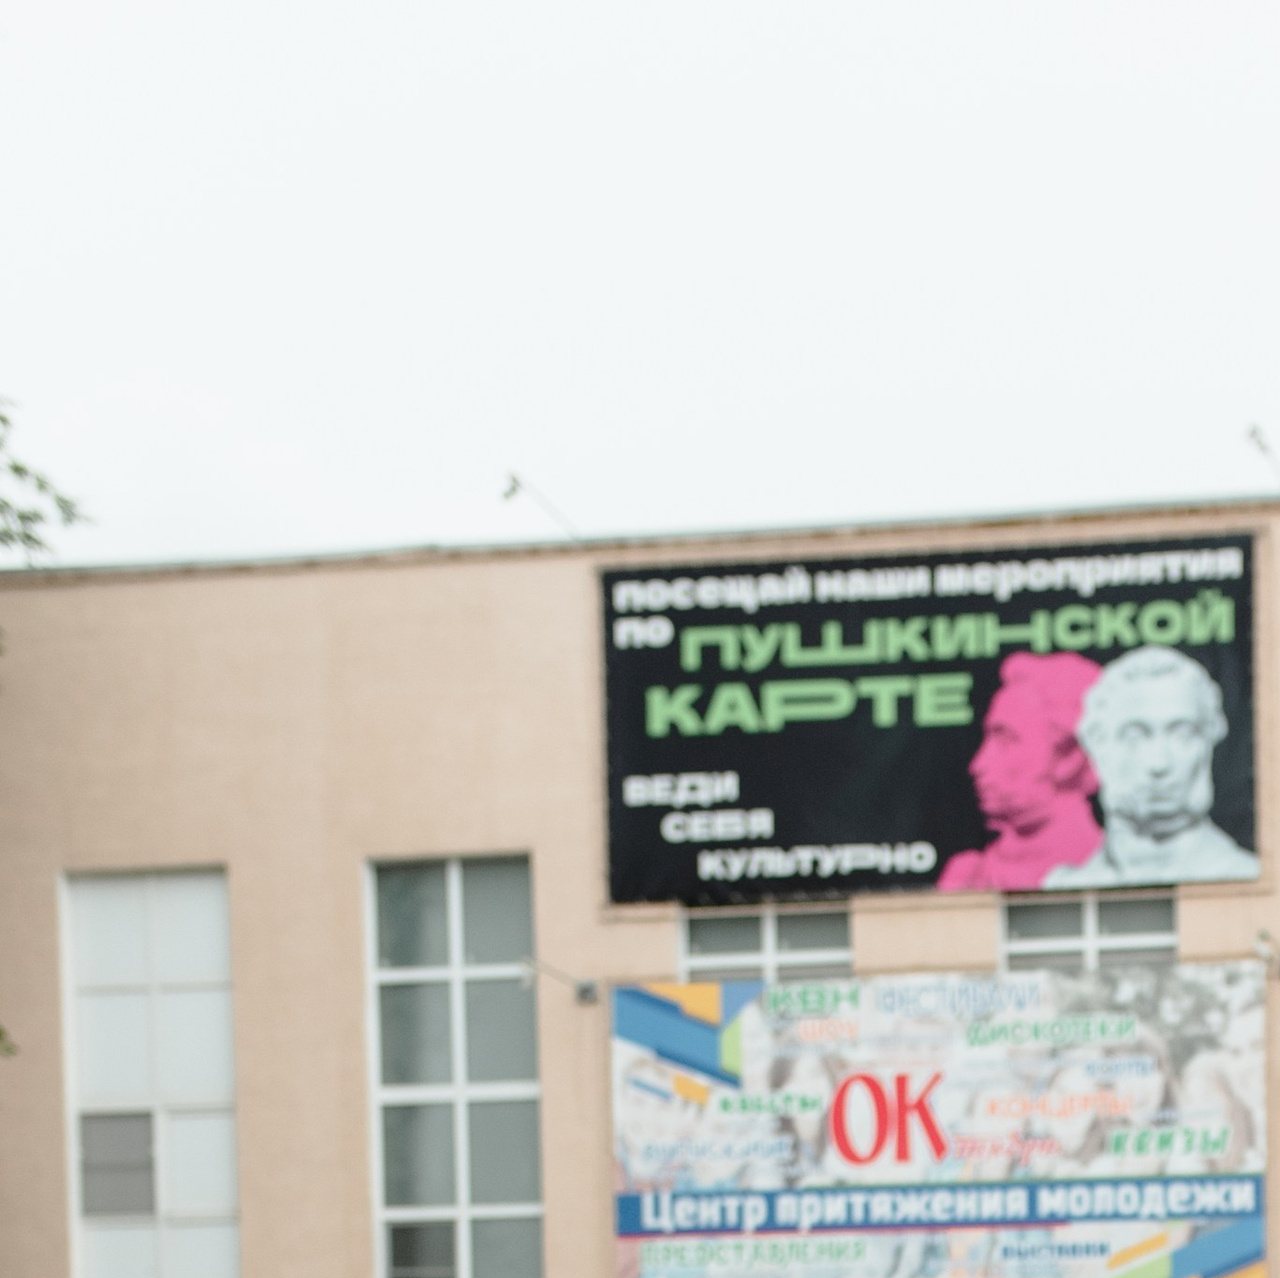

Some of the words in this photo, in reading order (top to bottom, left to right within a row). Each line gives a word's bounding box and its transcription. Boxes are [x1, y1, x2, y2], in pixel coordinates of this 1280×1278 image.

[613, 566, 812, 613] посещай
[815, 565, 932, 602] наши
[934, 547, 1244, 602] мероприятия
[613, 616, 673, 649] по
[679, 589, 1235, 672] ПУШКИНСКОЙ
[646, 673, 974, 737] КАРТЕ
[623, 770, 739, 807] ВЕДИ
[661, 809, 773, 843] СЕБЯ
[698, 842, 936, 880] КУЛЬТУРНО
[642, 1193, 768, 1233] Центр
[776, 1186, 1030, 1230] притяжения
[1038, 1179, 1256, 1222] молодежи
